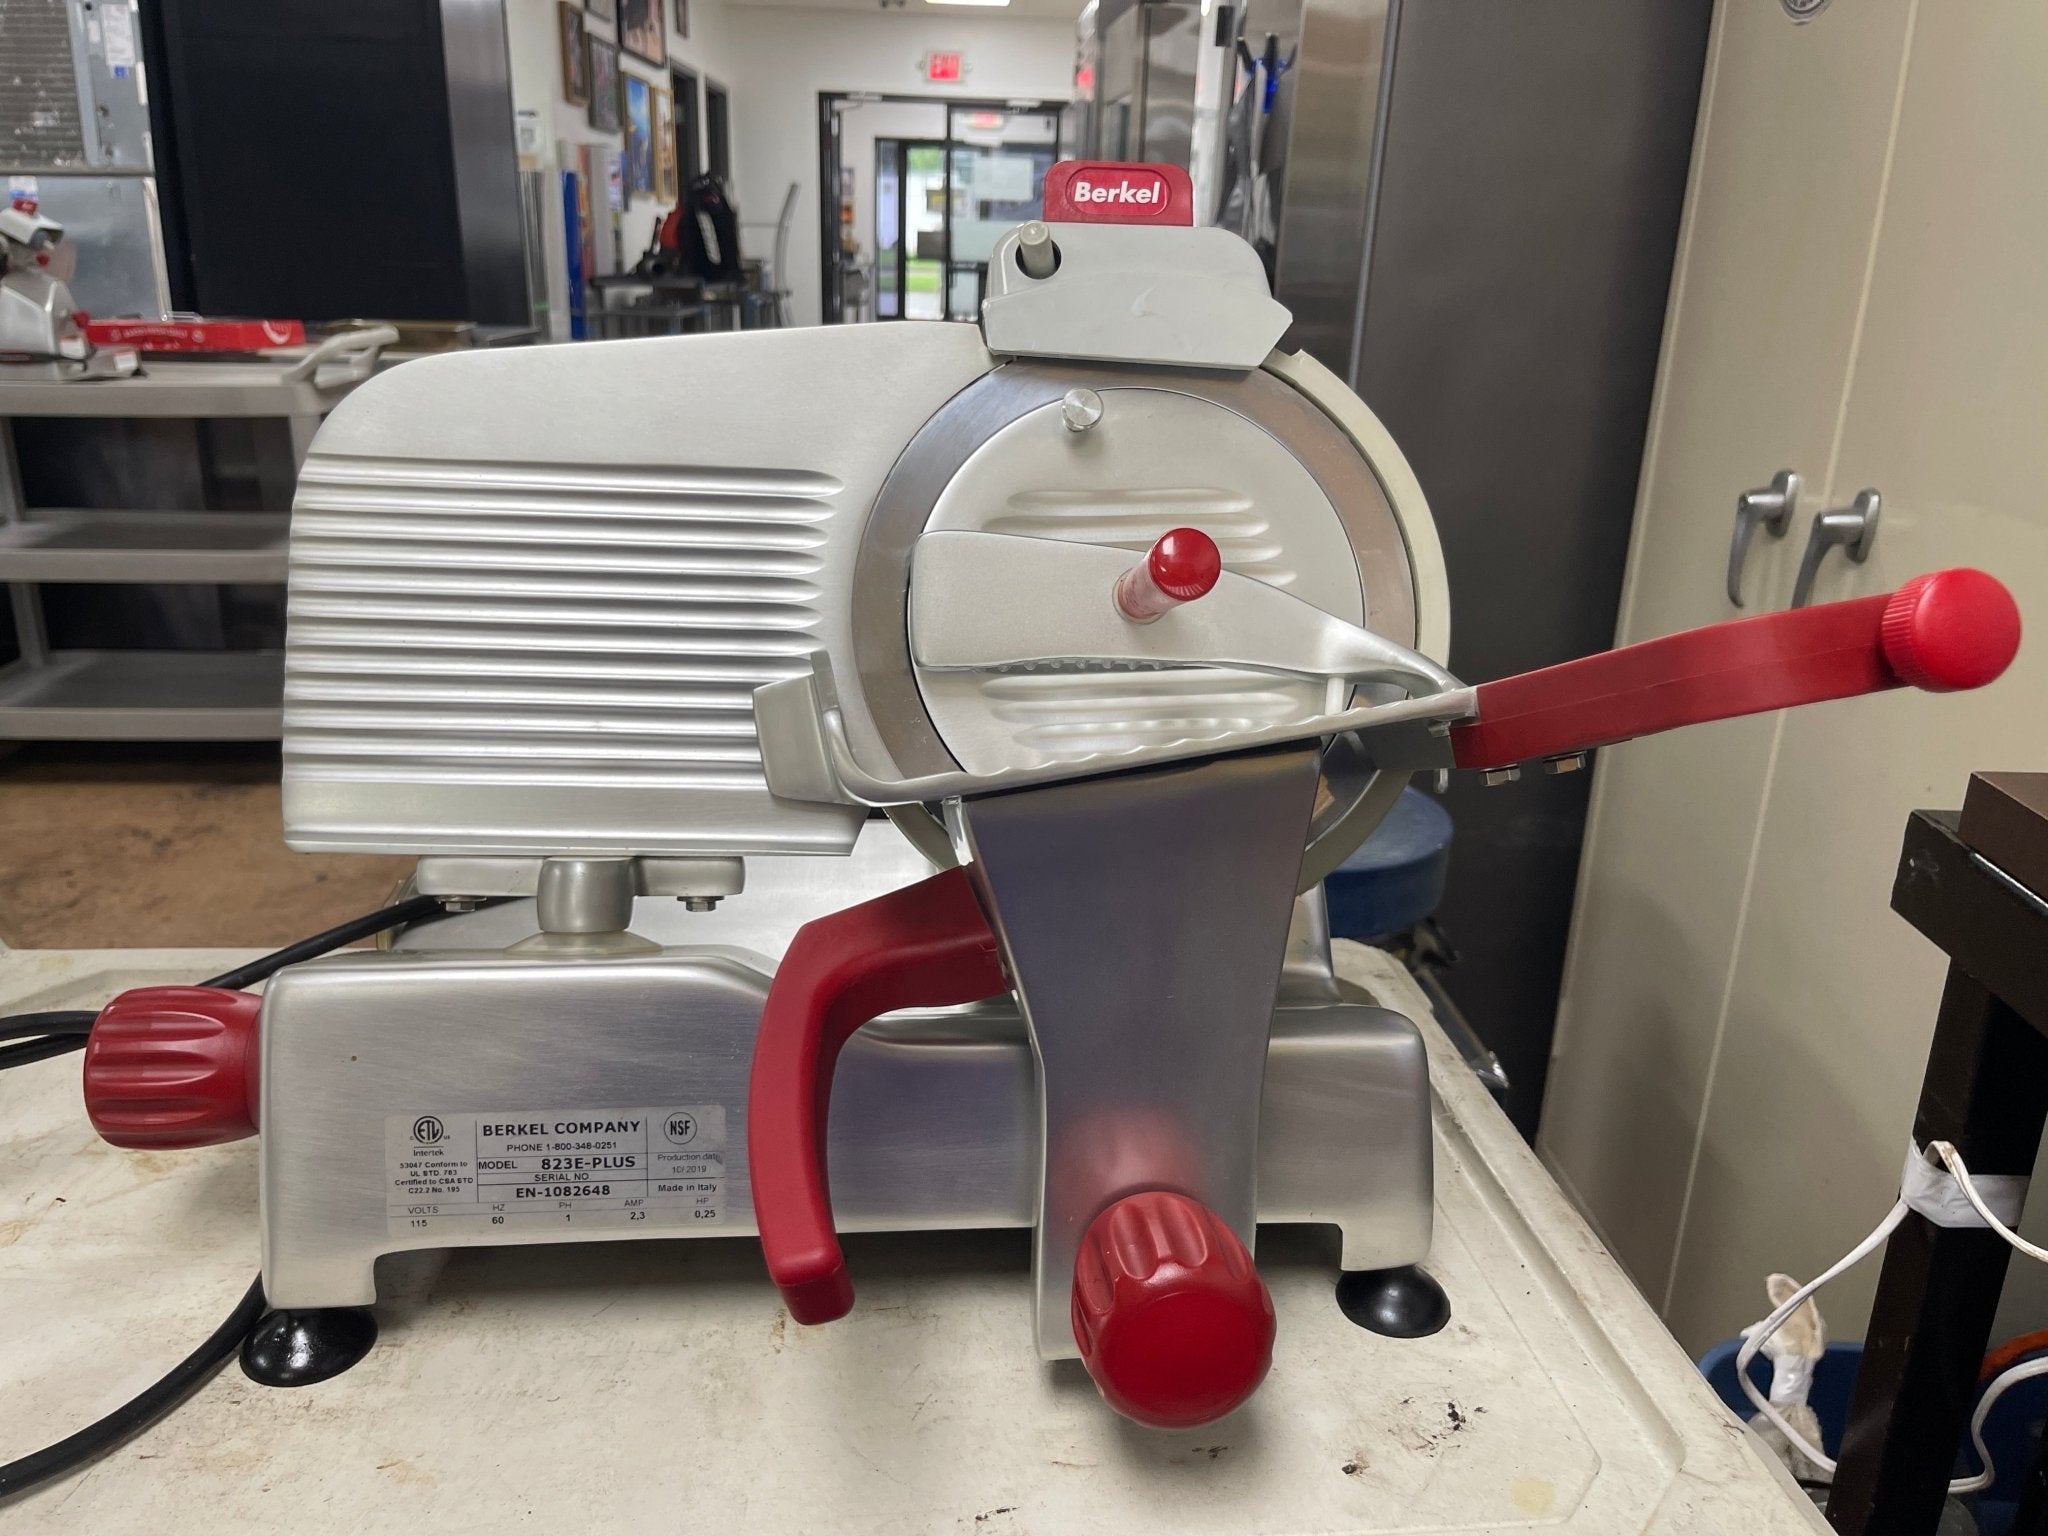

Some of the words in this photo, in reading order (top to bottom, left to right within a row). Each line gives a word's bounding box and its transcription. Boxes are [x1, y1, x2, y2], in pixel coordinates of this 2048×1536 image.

[1074, 180, 1161, 204] Berkel
[482, 1123, 549, 1137] BERKEL
[554, 1120, 641, 1135] COMPANY
[670, 1120, 691, 1136] NSF
[413, 1149, 444, 1157] Intertek
[506, 1144, 543, 1152] PHONE
[545, 1141, 617, 1150] 1-800-348-0251
[478, 1160, 518, 1170] MODEL
[541, 1156, 636, 1170] 823E-PLUS
[657, 1152, 701, 1161] Production
[534, 1172, 571, 1182] SERIAL
[574, 1172, 591, 1181] NO.
[516, 1185, 611, 1198] EN-1082648
[658, 1184, 684, 1192] Made
[698, 1183, 717, 1192] Italy
[408, 1206, 439, 1215] VOLTS
[492, 1203, 505, 1212] HZ
[558, 1201, 572, 1209] PH
[624, 1199, 644, 1207] AMP
[696, 1197, 709, 1205] HP
[411, 1219, 427, 1228] 115
[491, 1216, 505, 1225] 60
[565, 1214, 571, 1222] 1
[630, 1211, 646, 1221] 2,3
[694, 1209, 716, 1219] 0,25
